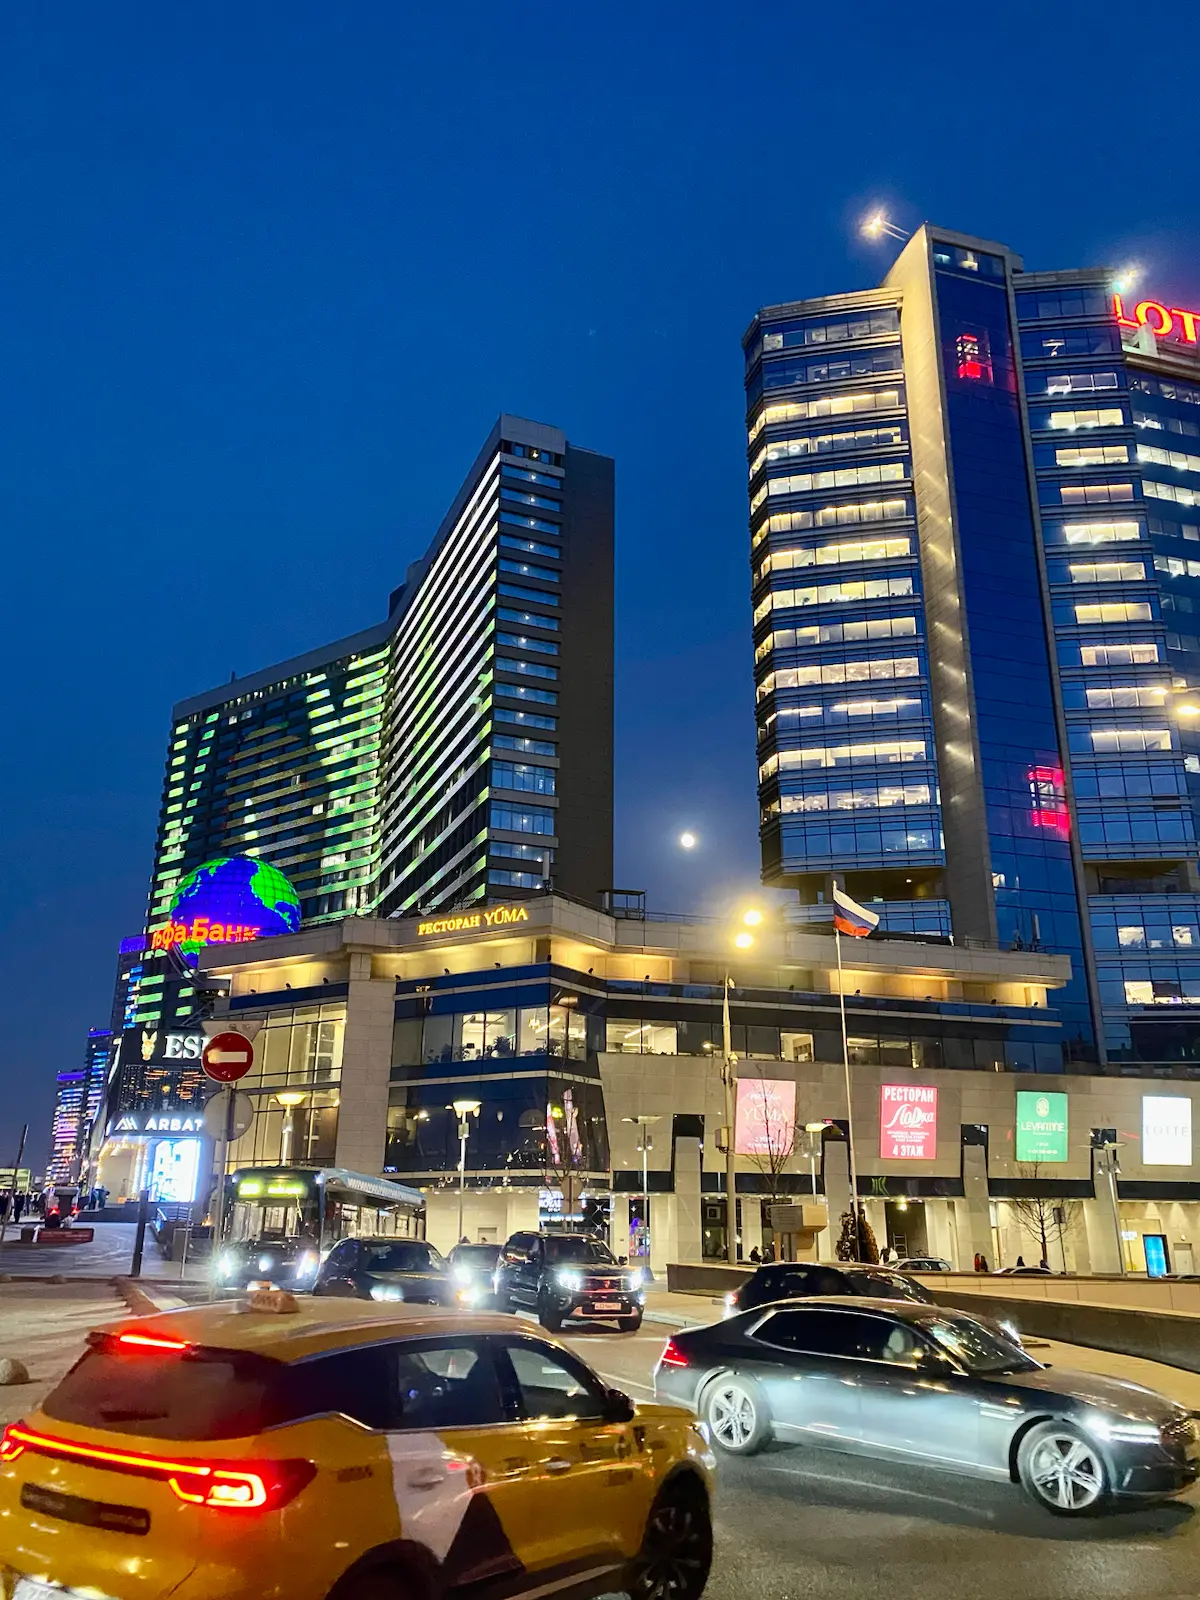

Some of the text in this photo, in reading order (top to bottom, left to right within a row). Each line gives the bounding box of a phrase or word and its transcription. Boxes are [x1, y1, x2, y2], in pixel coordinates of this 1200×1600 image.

[191, 918, 260, 942] Банк
[418, 915, 480, 936] РЕСТОРАН
[884, 1087, 934, 1103] РЕСТОРАН
[144, 1118, 203, 1132] ARBAT
[892, 1144, 924, 1157] 4 ЭТАЖ
